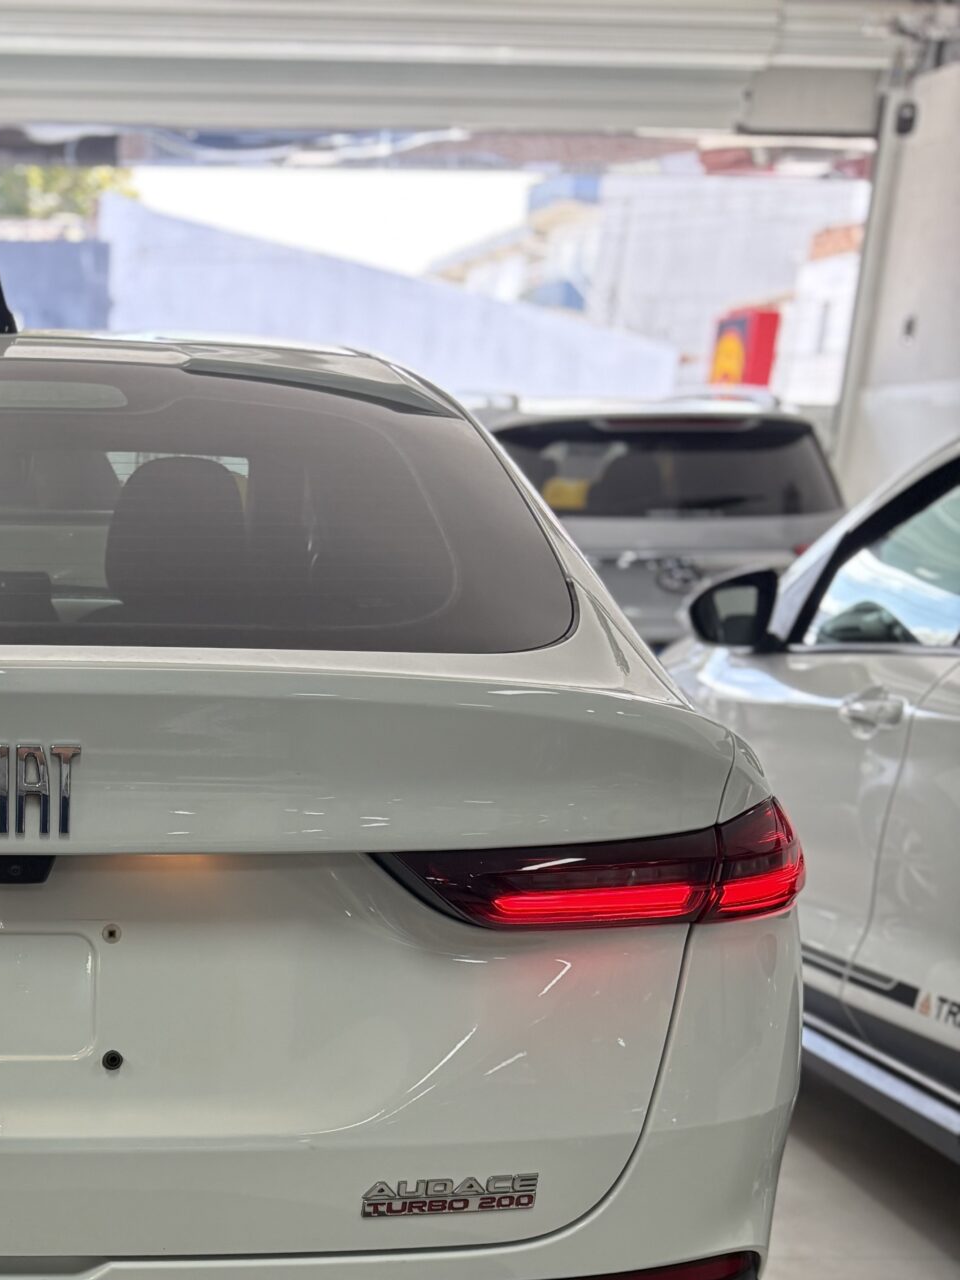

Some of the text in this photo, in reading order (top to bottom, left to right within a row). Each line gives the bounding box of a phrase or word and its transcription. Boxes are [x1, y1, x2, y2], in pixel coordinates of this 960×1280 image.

[935, 995, 960, 1028] TR
[362, 1172, 539, 1200] AUDACE
[367, 1194, 535, 1216] TURBO 200
